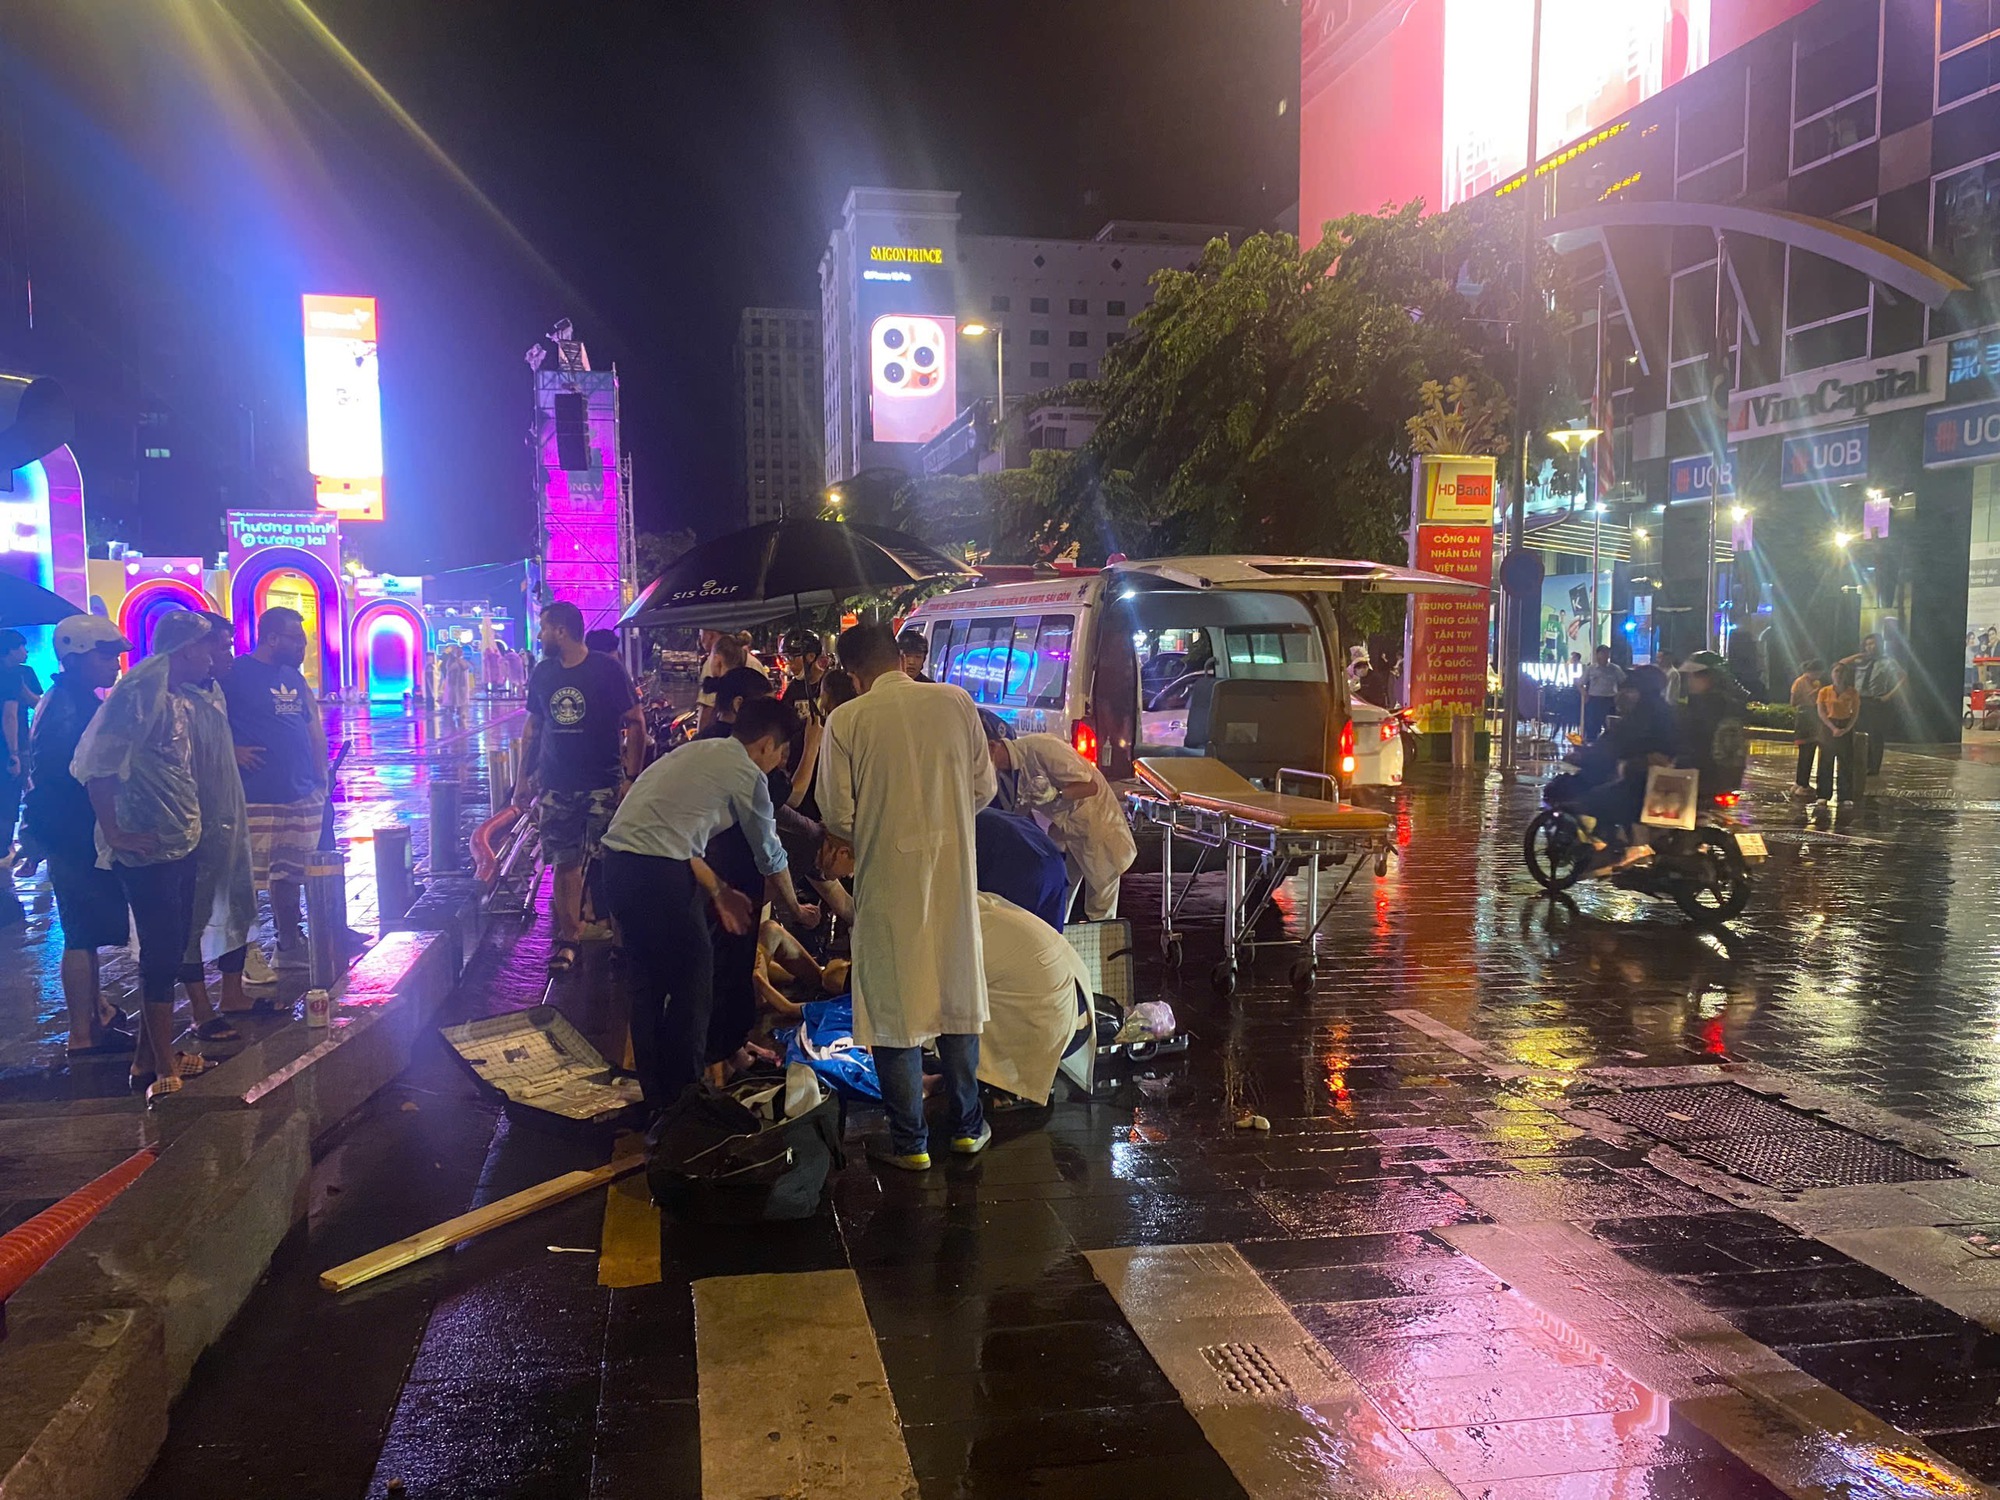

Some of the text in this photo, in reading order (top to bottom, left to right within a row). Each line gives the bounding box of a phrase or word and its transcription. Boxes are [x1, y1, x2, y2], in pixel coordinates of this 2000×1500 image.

[870, 245, 943, 264] SAIGON PRINCE
[1750, 354, 1929, 428] VinaCapital
[1813, 438, 1862, 469] UOB
[1693, 462, 1733, 489] UOB
[1437, 483, 1488, 496] HDBank
[229, 517, 336, 539] Thương mình
[256, 534, 305, 547] tương
[307, 534, 326, 546] lai
[1433, 533, 1481, 544] CÔNG AN
[1430, 547, 1481, 558] NHÂN DÂN
[1433, 562, 1478, 575] VIỆT NAM
[672, 585, 739, 601] SIS GOLF
[1418, 602, 1453, 611] TRUNG
[1440, 644, 1454, 653] AN
[1456, 644, 1478, 653] NINH
[1425, 685, 1454, 696] NHÂN
